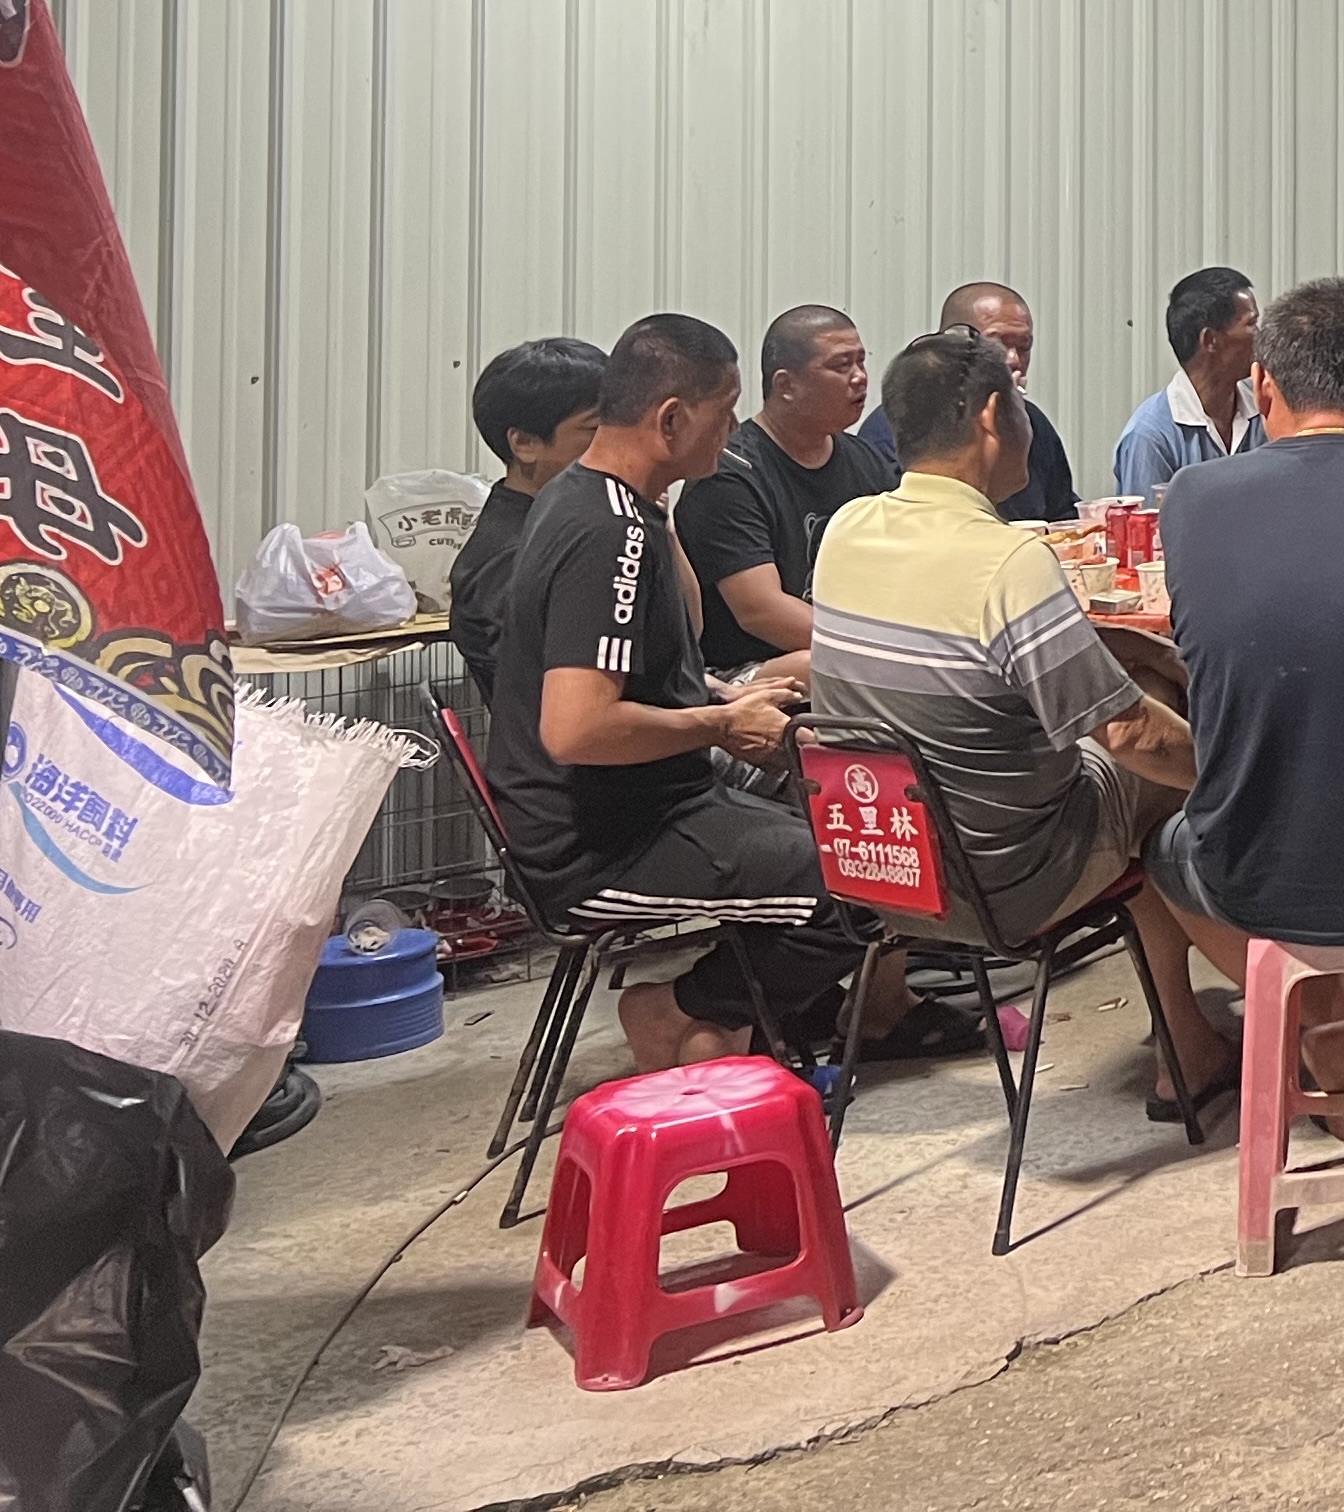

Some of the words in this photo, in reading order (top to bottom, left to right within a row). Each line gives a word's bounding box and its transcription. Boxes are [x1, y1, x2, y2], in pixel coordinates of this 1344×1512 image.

[613, 525, 645, 624] adidas
[826, 803, 919, 841] 五里林
